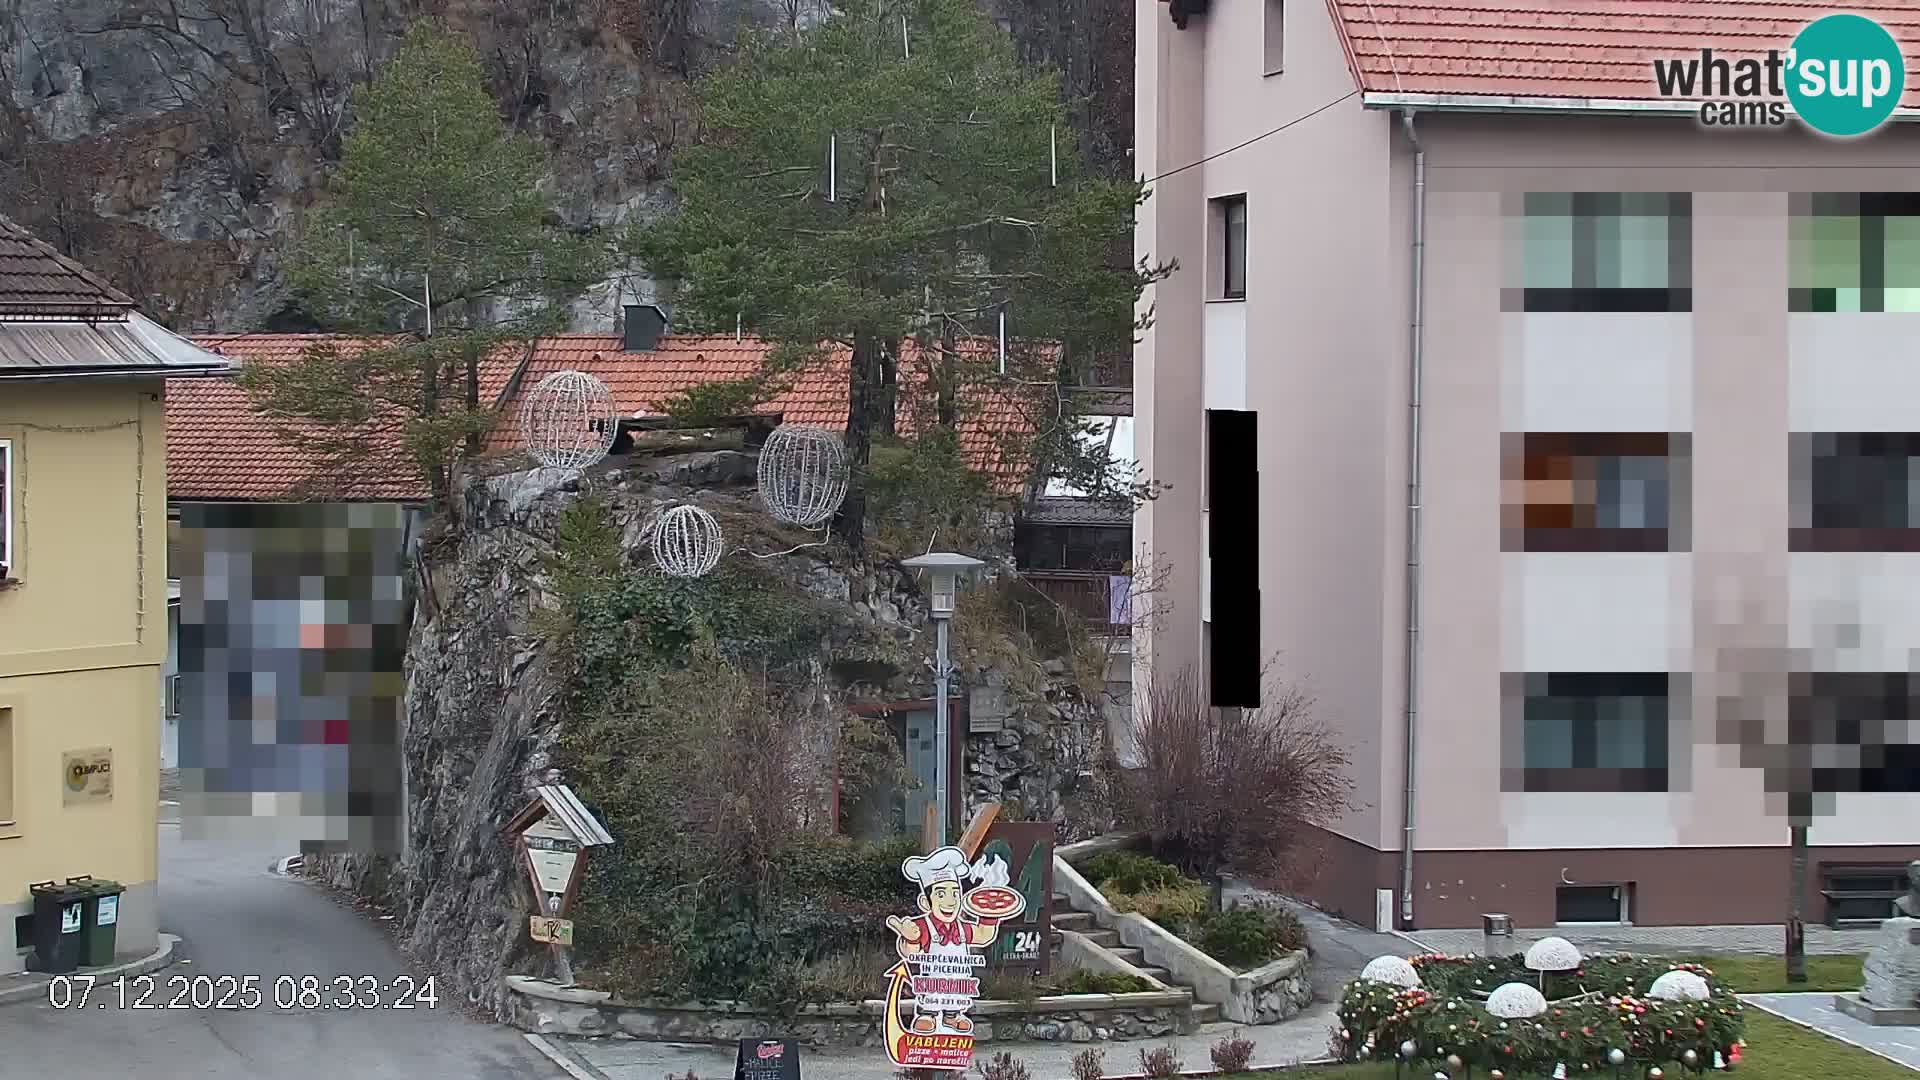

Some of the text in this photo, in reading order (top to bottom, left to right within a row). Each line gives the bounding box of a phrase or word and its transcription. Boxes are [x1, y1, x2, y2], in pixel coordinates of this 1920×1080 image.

[909, 953, 984, 965] OKREPČEVALNICA
[922, 964, 971, 974] IN PICERIJA
[914, 977, 977, 995] KURNIK
[906, 1036, 973, 1049] VABLJENI
[904, 1054, 921, 1064] jedi
[923, 1057, 934, 1065] po
